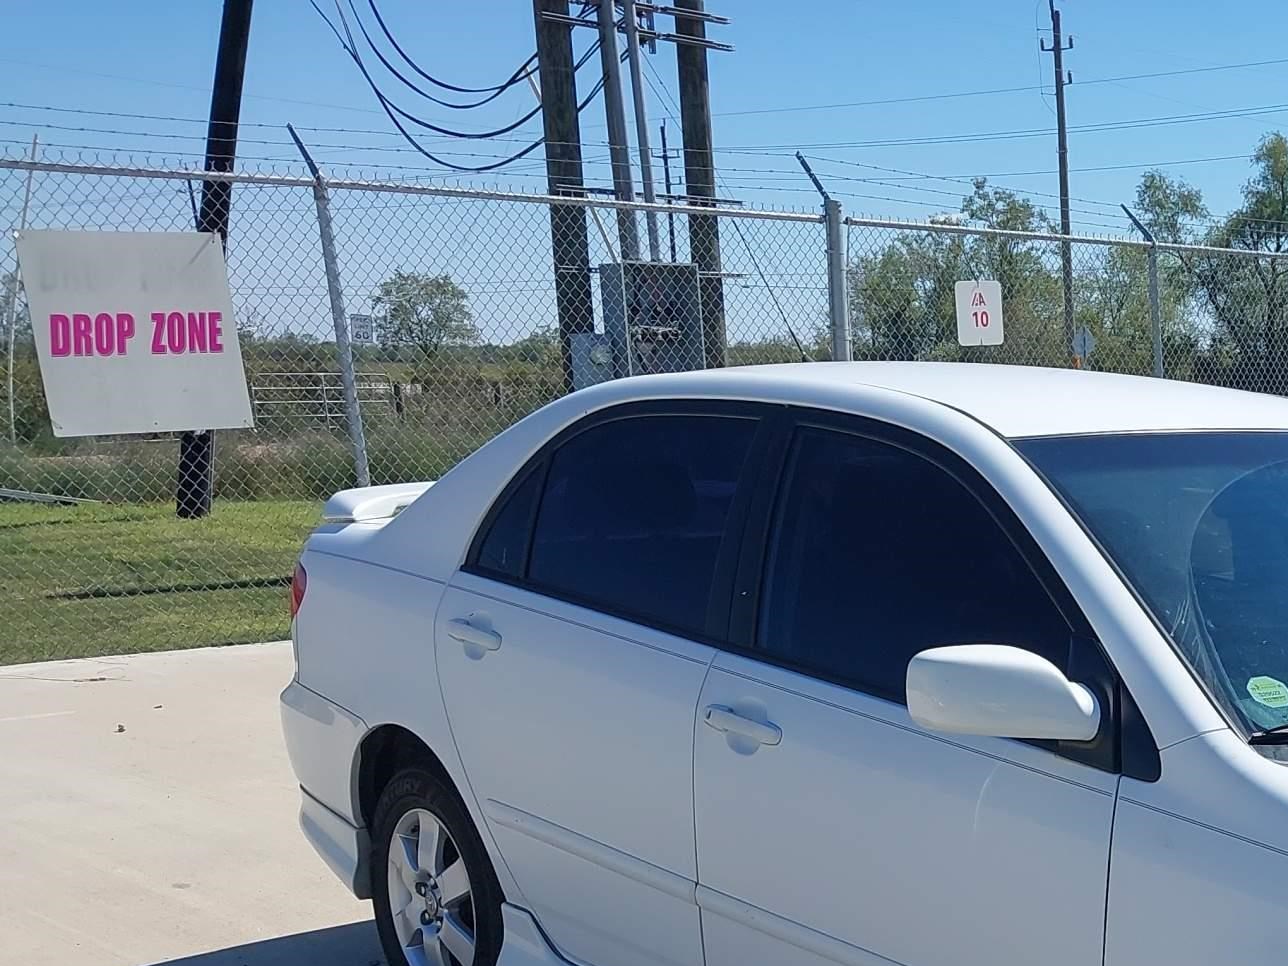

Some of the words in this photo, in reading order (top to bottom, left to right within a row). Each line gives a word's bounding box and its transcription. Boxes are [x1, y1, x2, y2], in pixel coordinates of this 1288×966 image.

[49, 313, 136, 358] DROP
[151, 311, 224, 355] ZONE
[972, 311, 989, 328] 10
